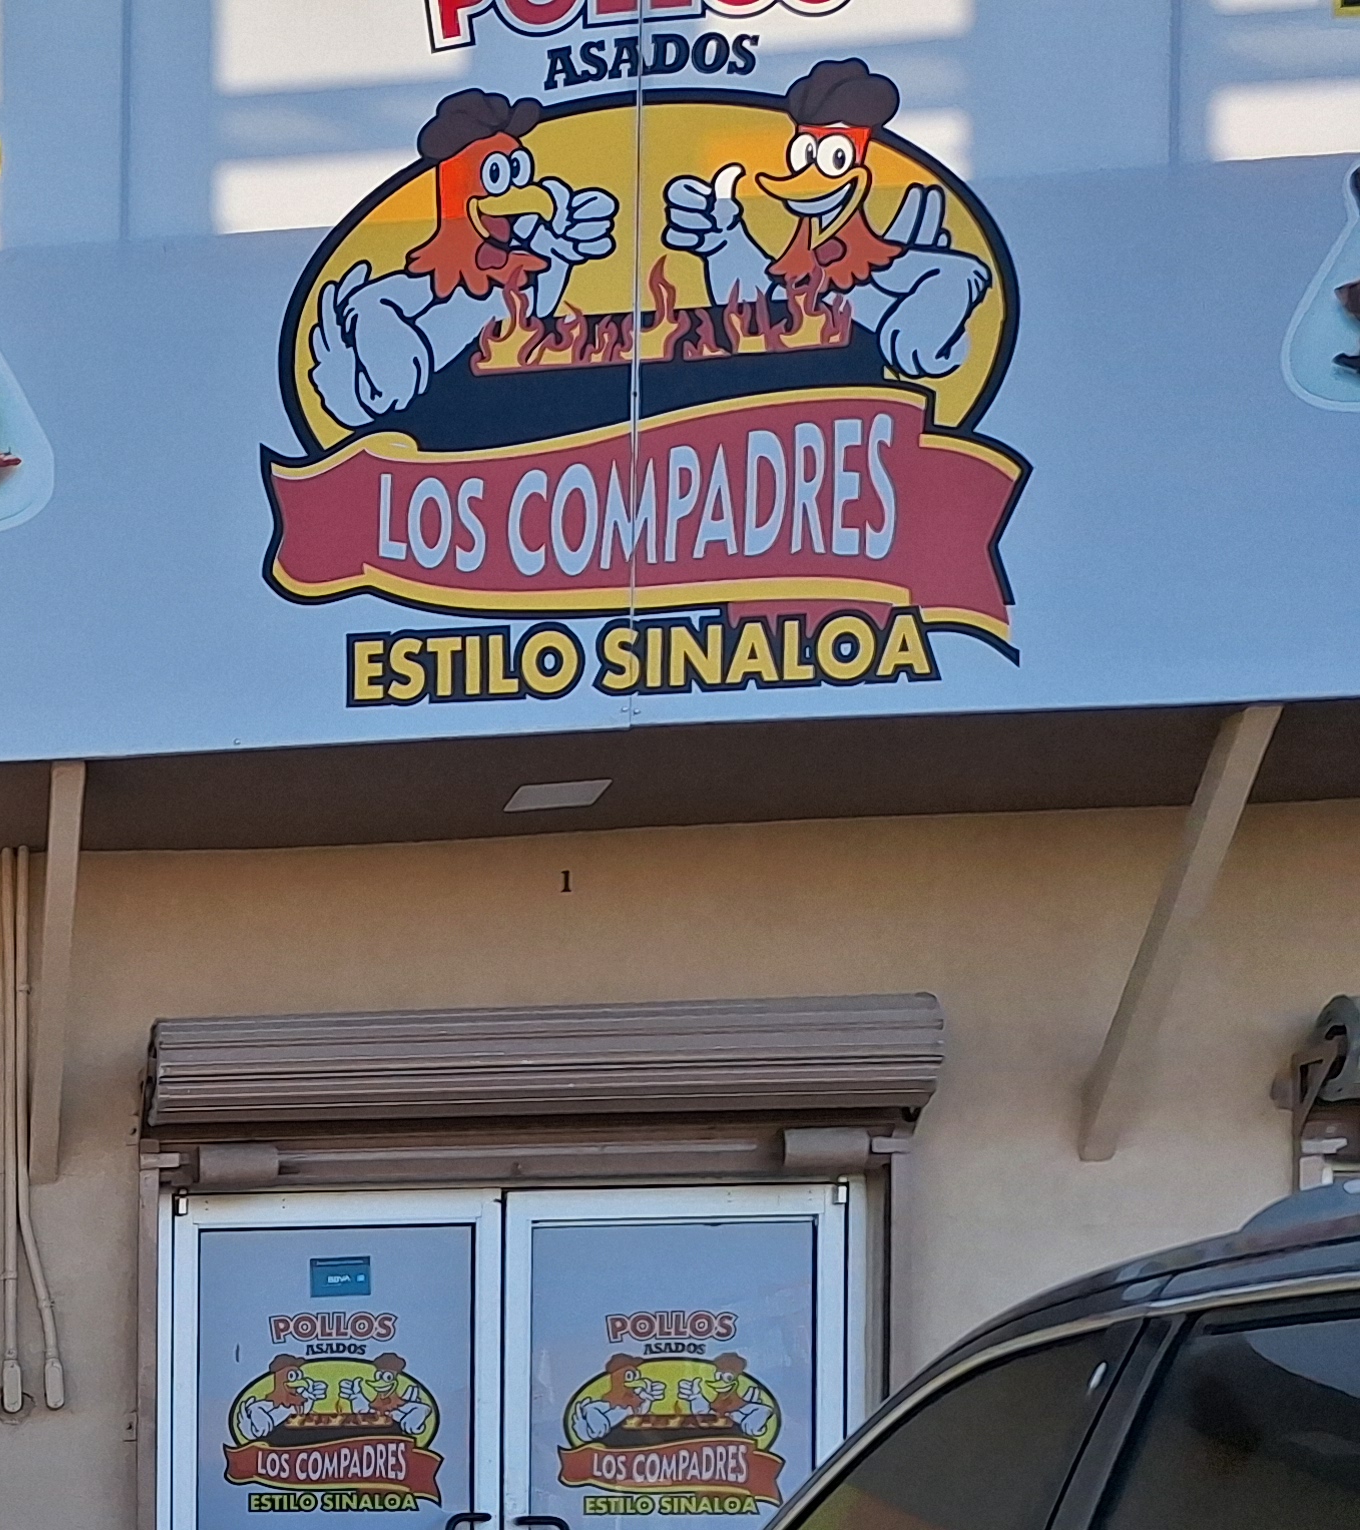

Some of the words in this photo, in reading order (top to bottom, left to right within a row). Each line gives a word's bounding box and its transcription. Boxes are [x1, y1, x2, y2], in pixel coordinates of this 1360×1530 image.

[544, 34, 759, 90] ASADOS
[379, 472, 486, 573] LOS
[507, 412, 897, 577] COMPADRES
[350, 634, 583, 704] ESTILO
[596, 611, 936, 694] SINALOA
[270, 1312, 397, 1343] POLLOS
[606, 1311, 738, 1343] POLLOS
[306, 1343, 367, 1355] ASADOS
[643, 1343, 707, 1355] ASADOS
[257, 1451, 290, 1478] LOS
[295, 1443, 407, 1481] COMPADRES
[593, 1452, 626, 1480] LOS
[632, 1445, 748, 1483] COMPADRES
[248, 1493, 318, 1512] ESTILO
[320, 1492, 419, 1511] SINALOA
[584, 1495, 655, 1515] ESTILO
[658, 1495, 760, 1515] SINALOA
